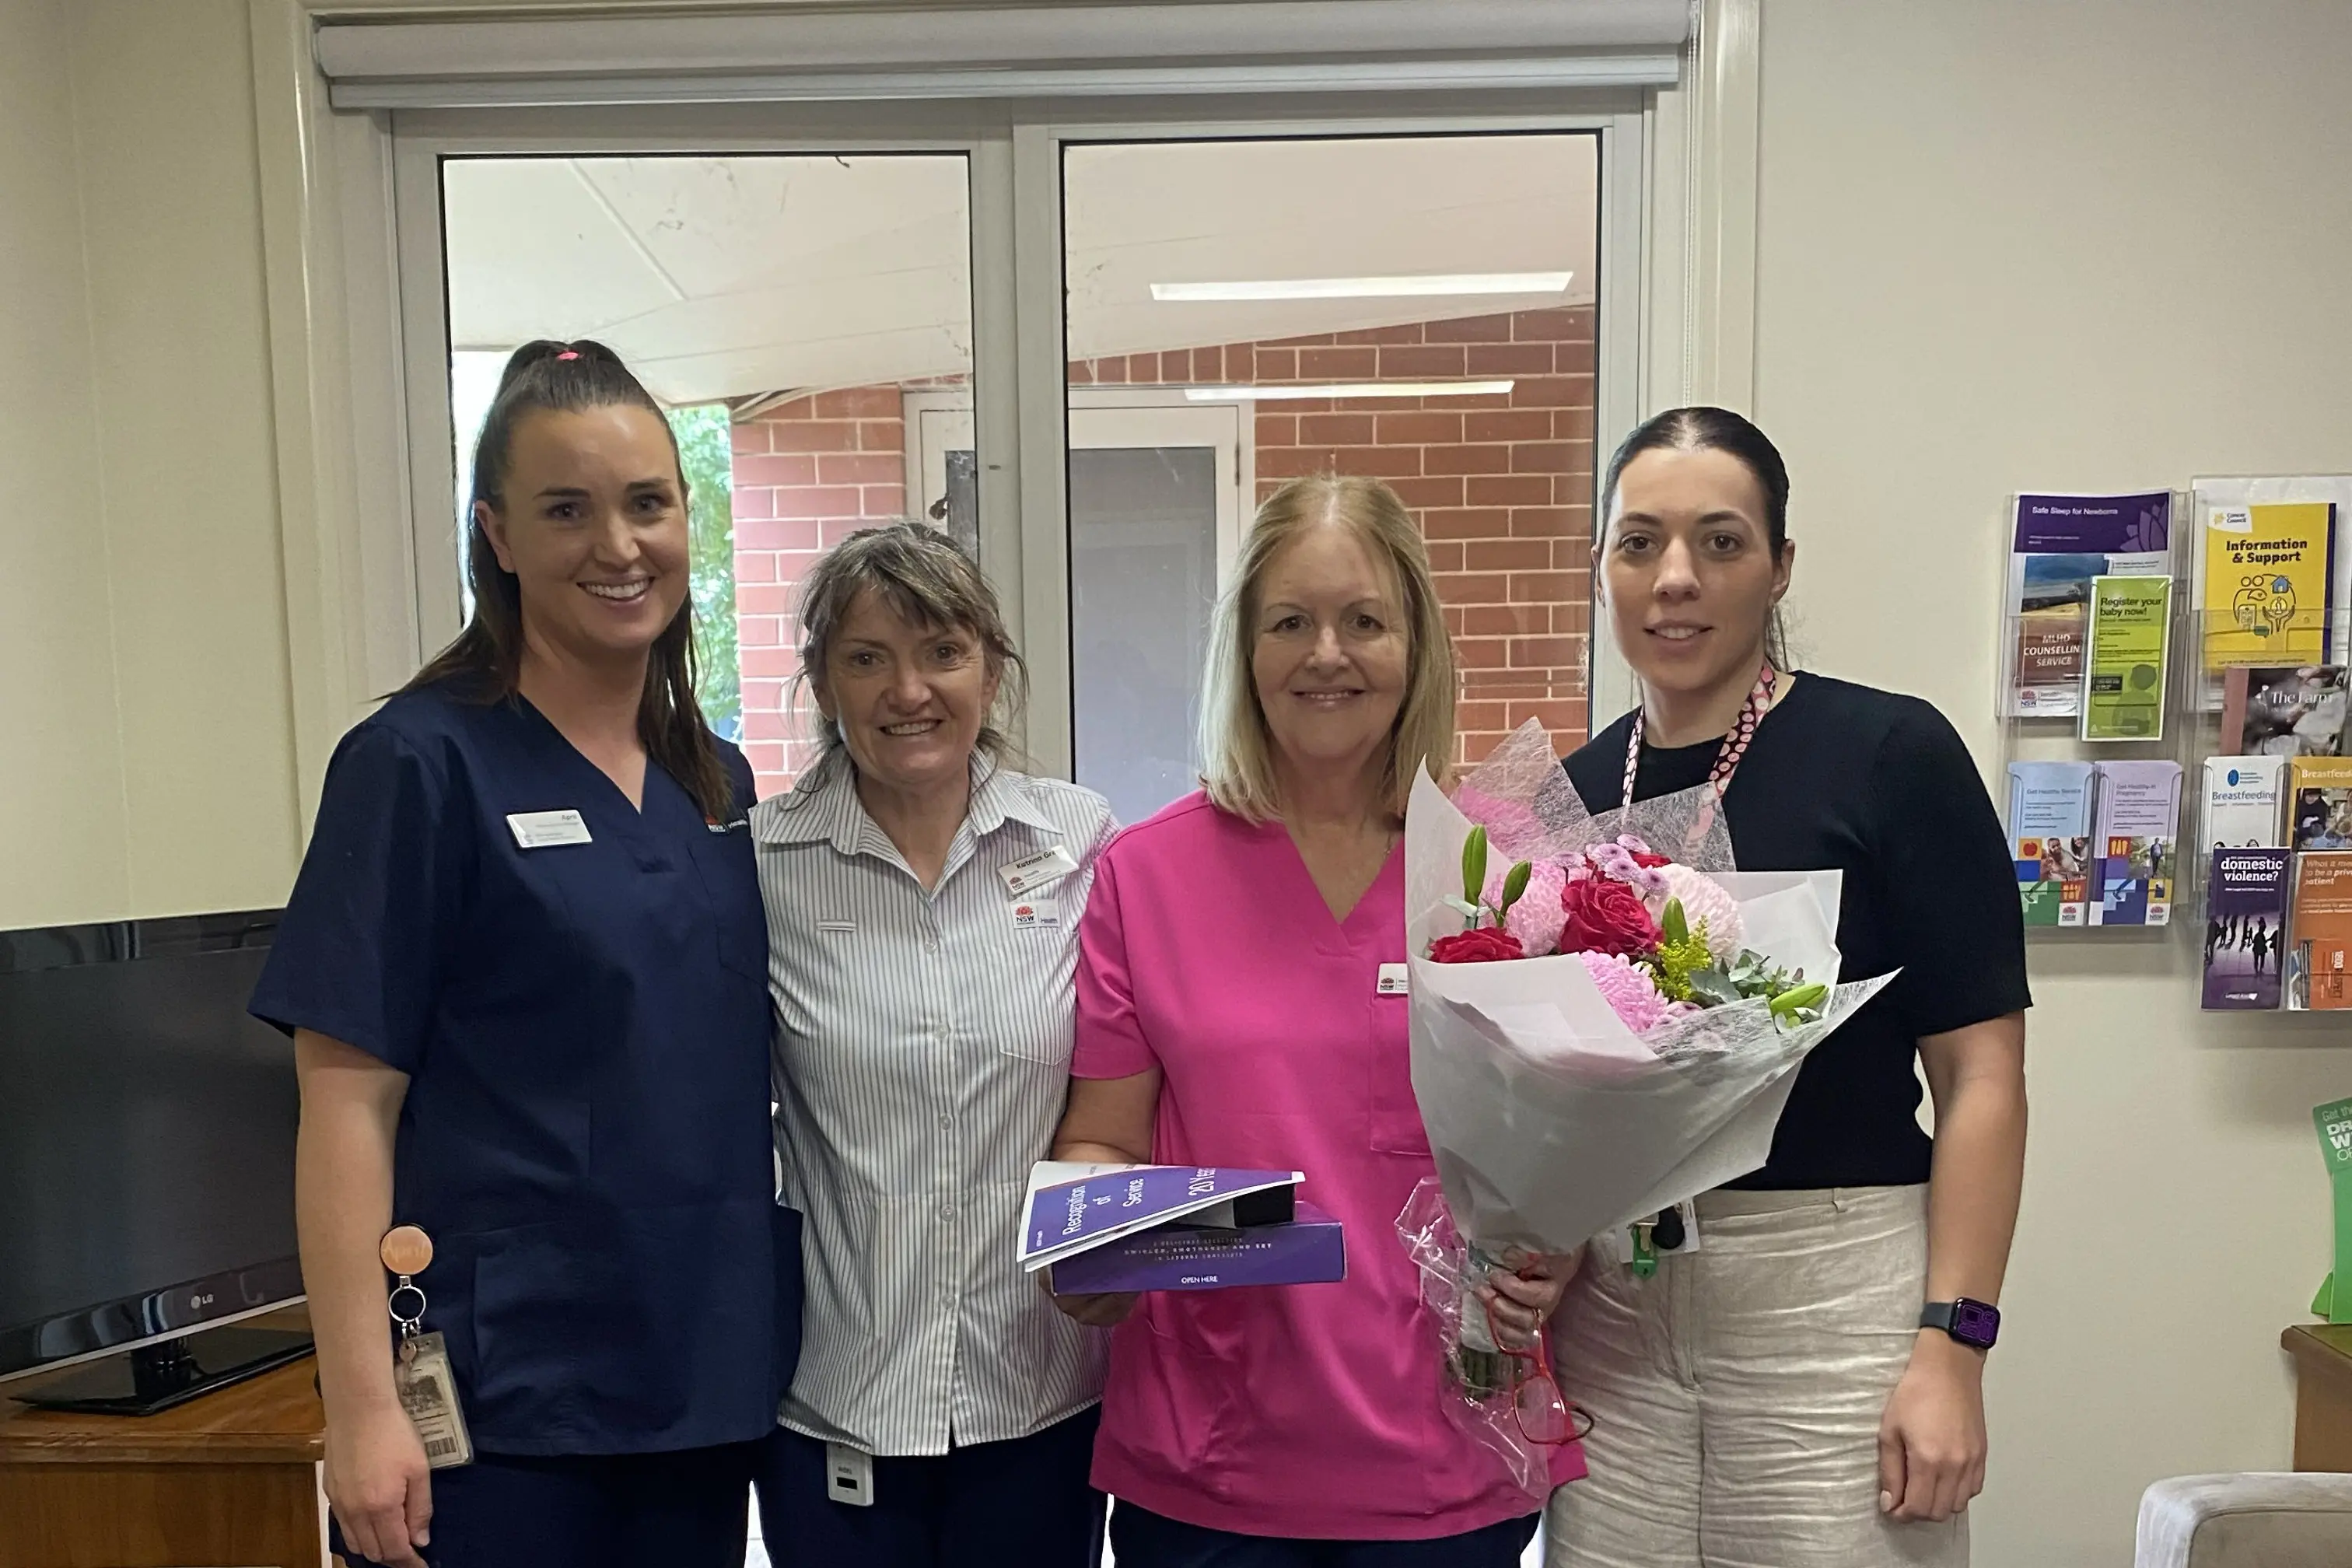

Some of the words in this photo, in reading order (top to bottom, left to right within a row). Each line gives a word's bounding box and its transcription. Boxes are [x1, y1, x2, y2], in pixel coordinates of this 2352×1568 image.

[2226, 537, 2308, 551] Information
[2231, 552, 2244, 563] &
[2246, 551, 2302, 566] Support
[2101, 597, 2139, 607] Register
[2140, 597, 2162, 607] your
[2100, 607, 2123, 617] baby
[2124, 607, 2147, 615] now!
[2024, 645, 2081, 656] COUNSELLIN
[2036, 656, 2073, 667] SERVICE
[2270, 690, 2295, 705] The
[2212, 789, 2276, 800] Breastfeeding
[2221, 856, 2284, 870] domestic
[2224, 870, 2279, 882] violence?
[2329, 1132, 2352, 1150] W
[1122, 1178, 1144, 1207] Service
[1188, 1181, 1214, 1196] 20
[1092, 1195, 1111, 1206] of
[1062, 1185, 1087, 1235] Recognition
[202, 1293, 214, 1304] LG
